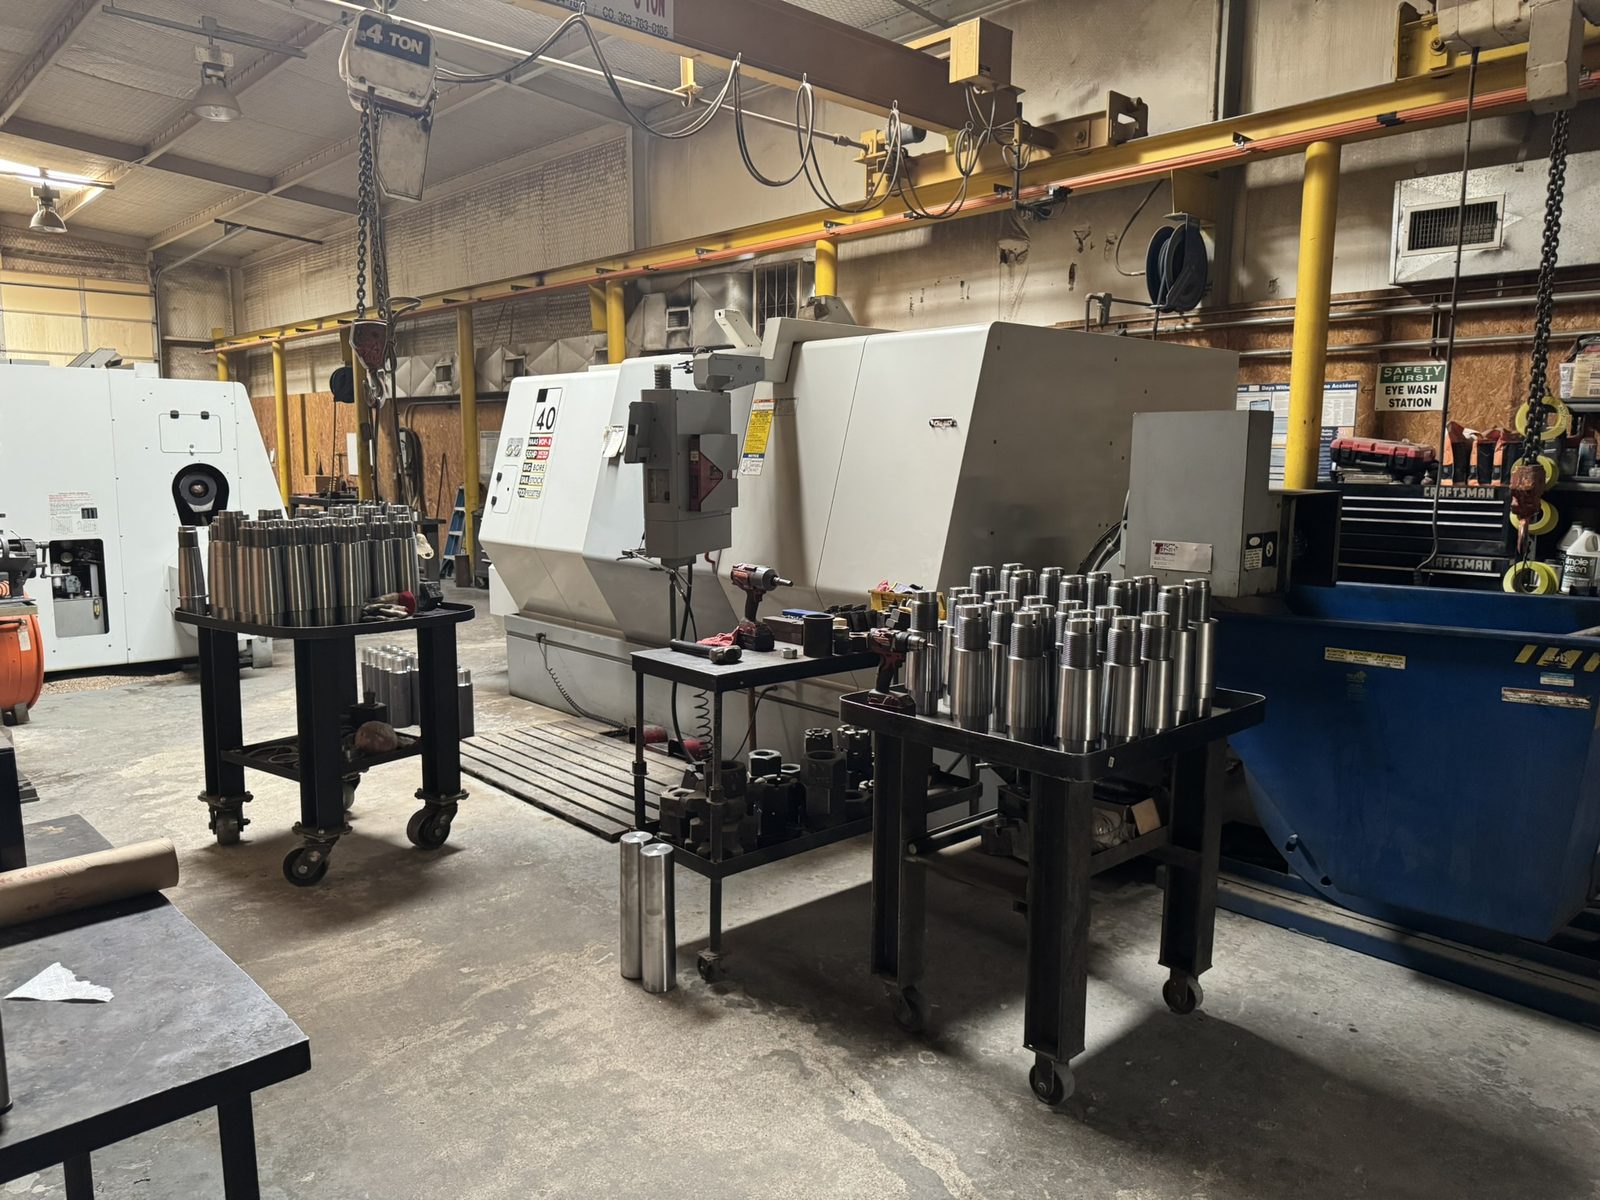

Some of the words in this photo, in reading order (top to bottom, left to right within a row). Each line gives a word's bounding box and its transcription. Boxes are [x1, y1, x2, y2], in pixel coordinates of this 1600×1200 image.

[389, 31, 424, 55] TON
[1384, 366, 1442, 378] SAFETY
[1393, 374, 1433, 382] FIRST
[1385, 385, 1404, 395] EYE
[1407, 384, 1437, 395] WASH
[1388, 398, 1432, 408] STATION
[536, 406, 556, 431] 40
[1564, 565, 1587, 573] green
